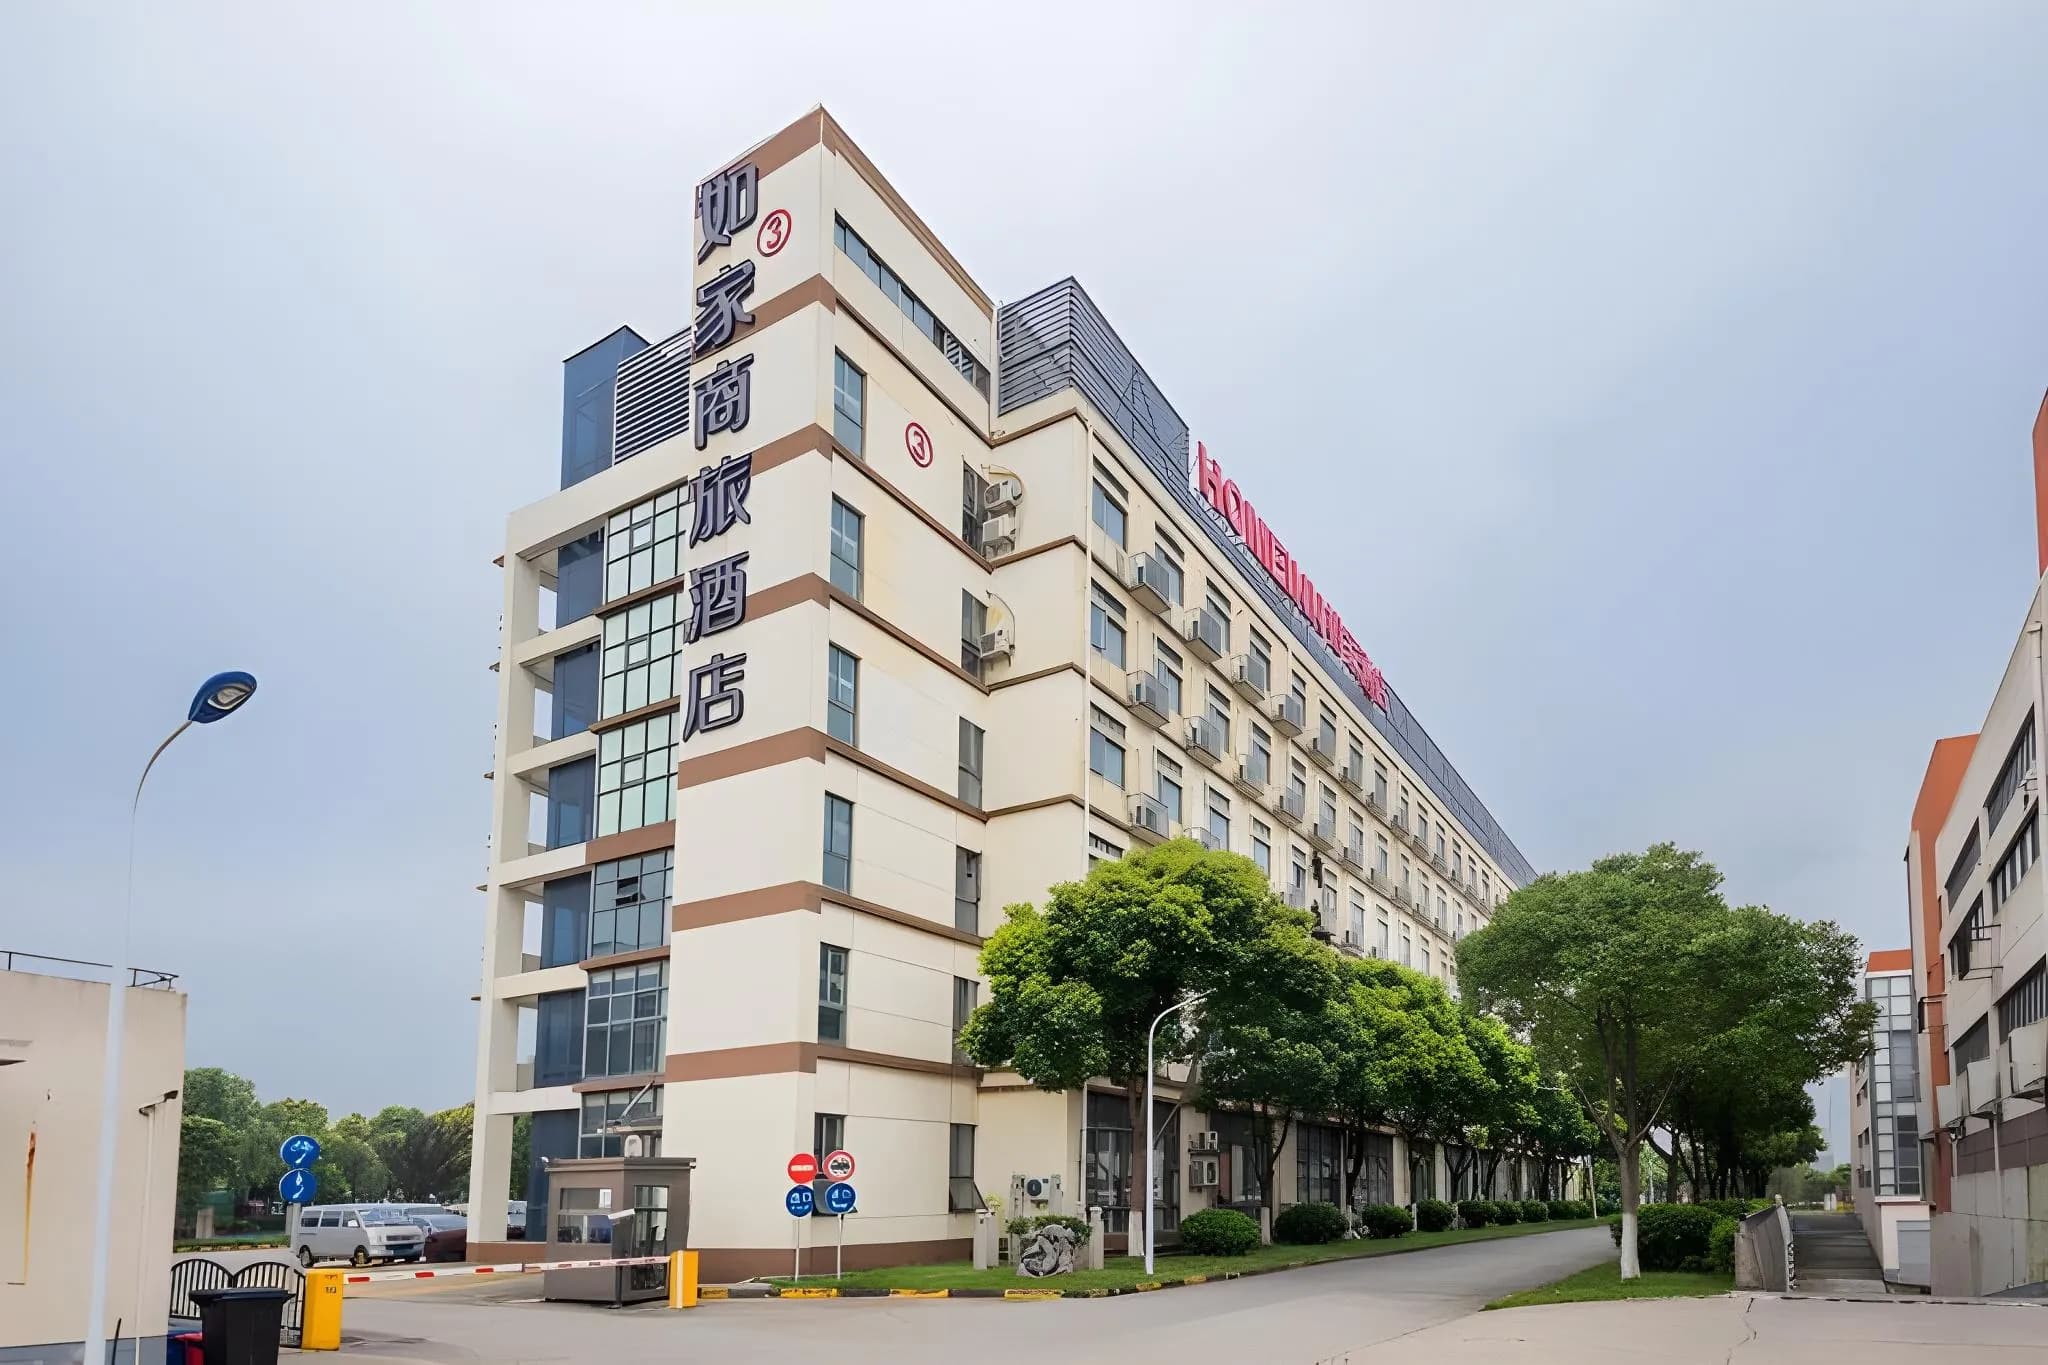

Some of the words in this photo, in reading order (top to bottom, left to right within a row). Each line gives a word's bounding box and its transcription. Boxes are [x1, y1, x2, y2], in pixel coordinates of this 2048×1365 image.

[683, 162, 759, 743] 如家商旅酒店
